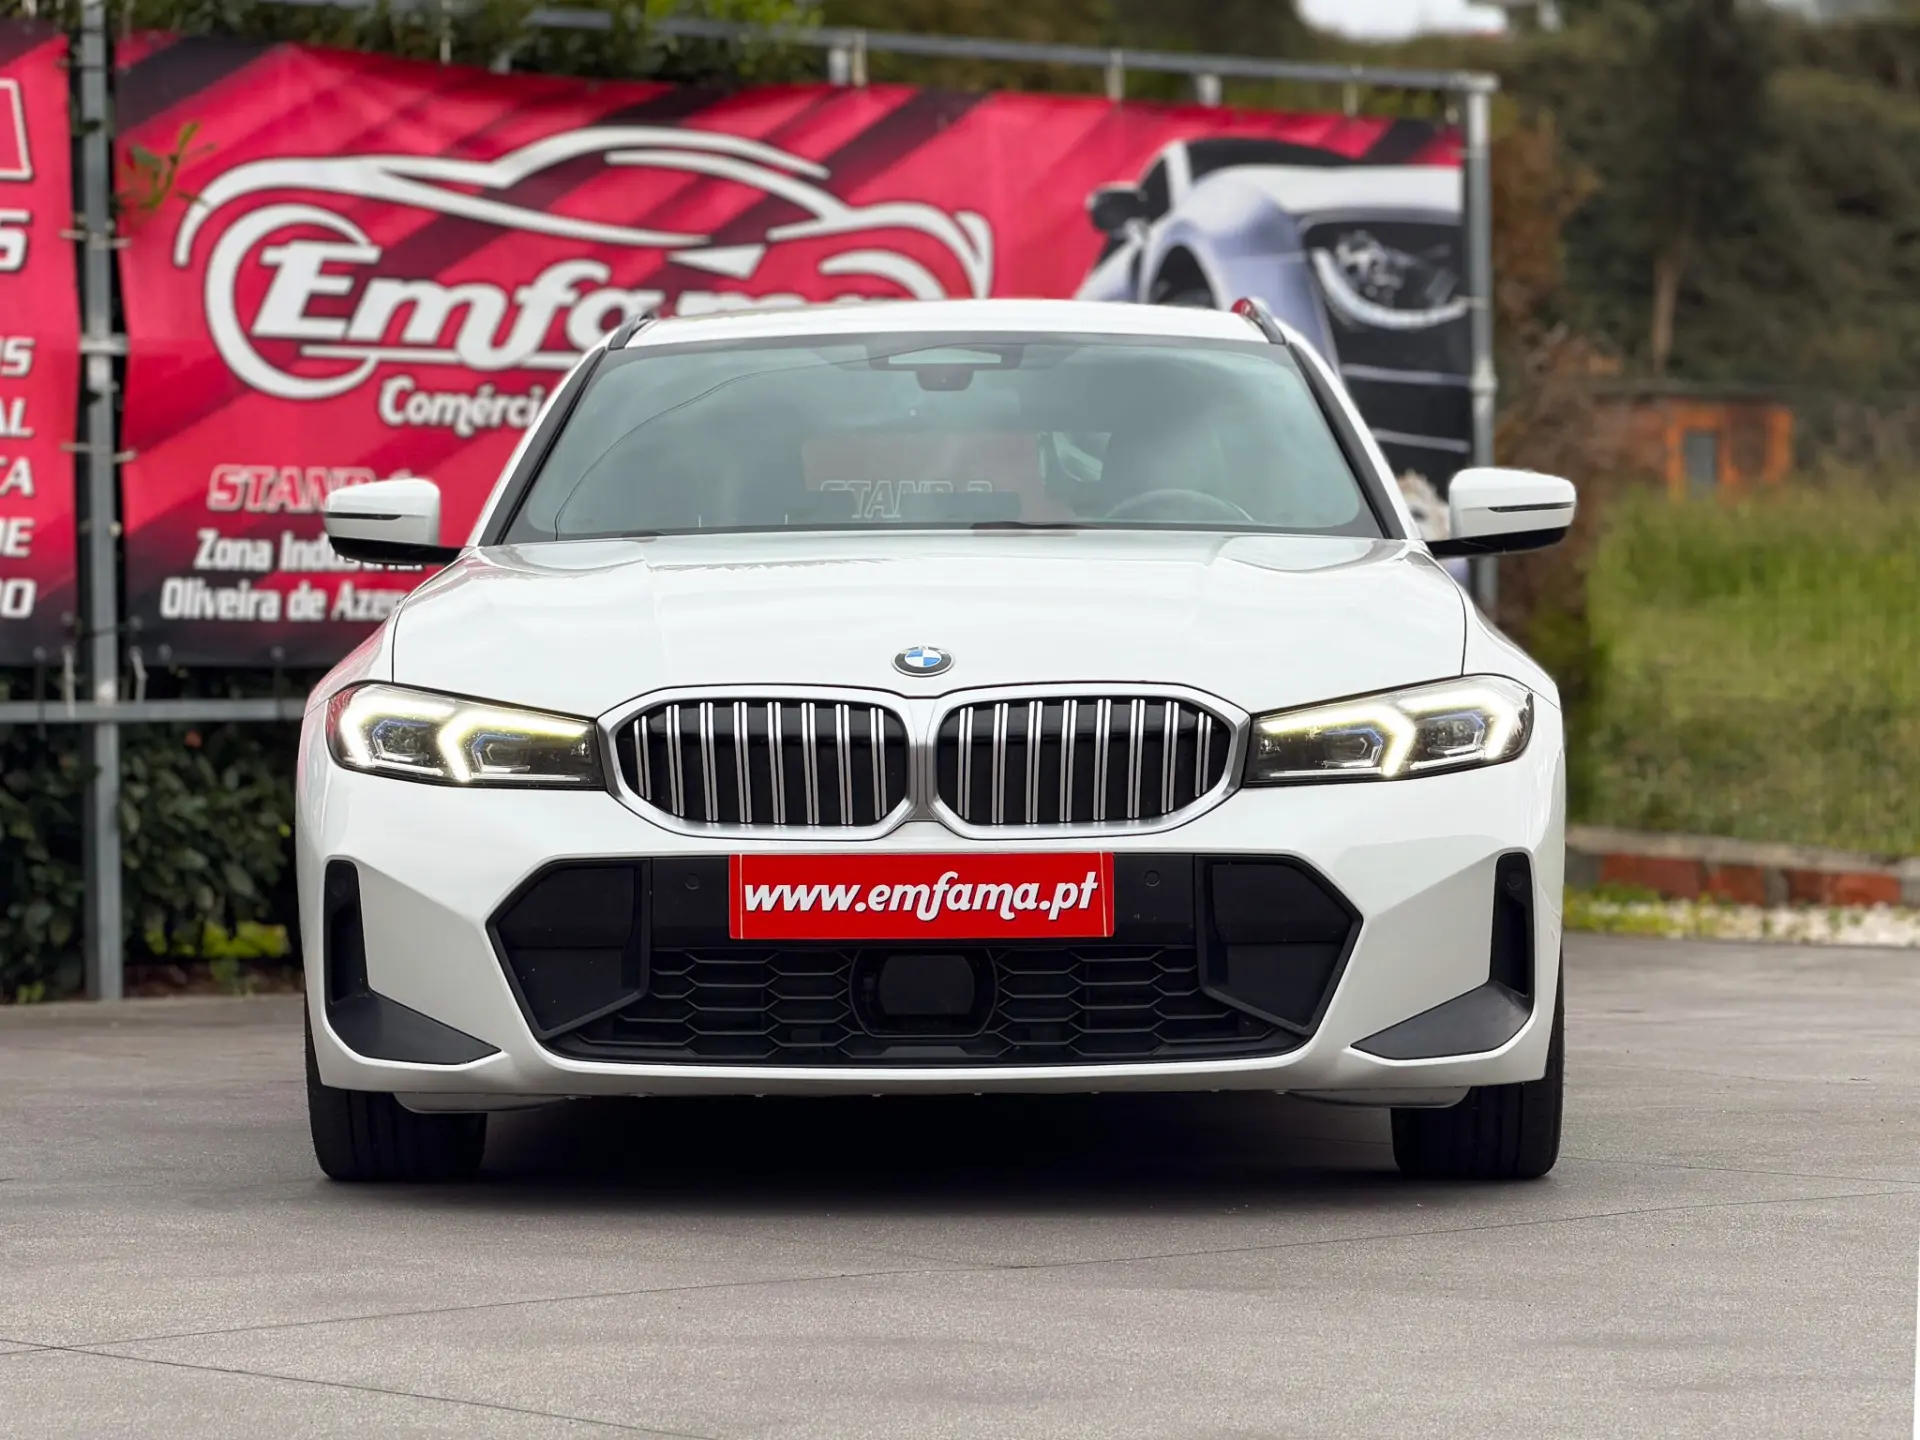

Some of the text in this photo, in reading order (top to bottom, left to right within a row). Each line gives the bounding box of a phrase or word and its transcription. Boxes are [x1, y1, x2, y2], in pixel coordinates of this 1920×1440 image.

[379, 375, 547, 438] Comérci
[194, 528, 273, 571] Zona
[160, 577, 281, 620] Oliveira
[286, 580, 327, 620] de
[744, 871, 1098, 921] www.emfama.pt
